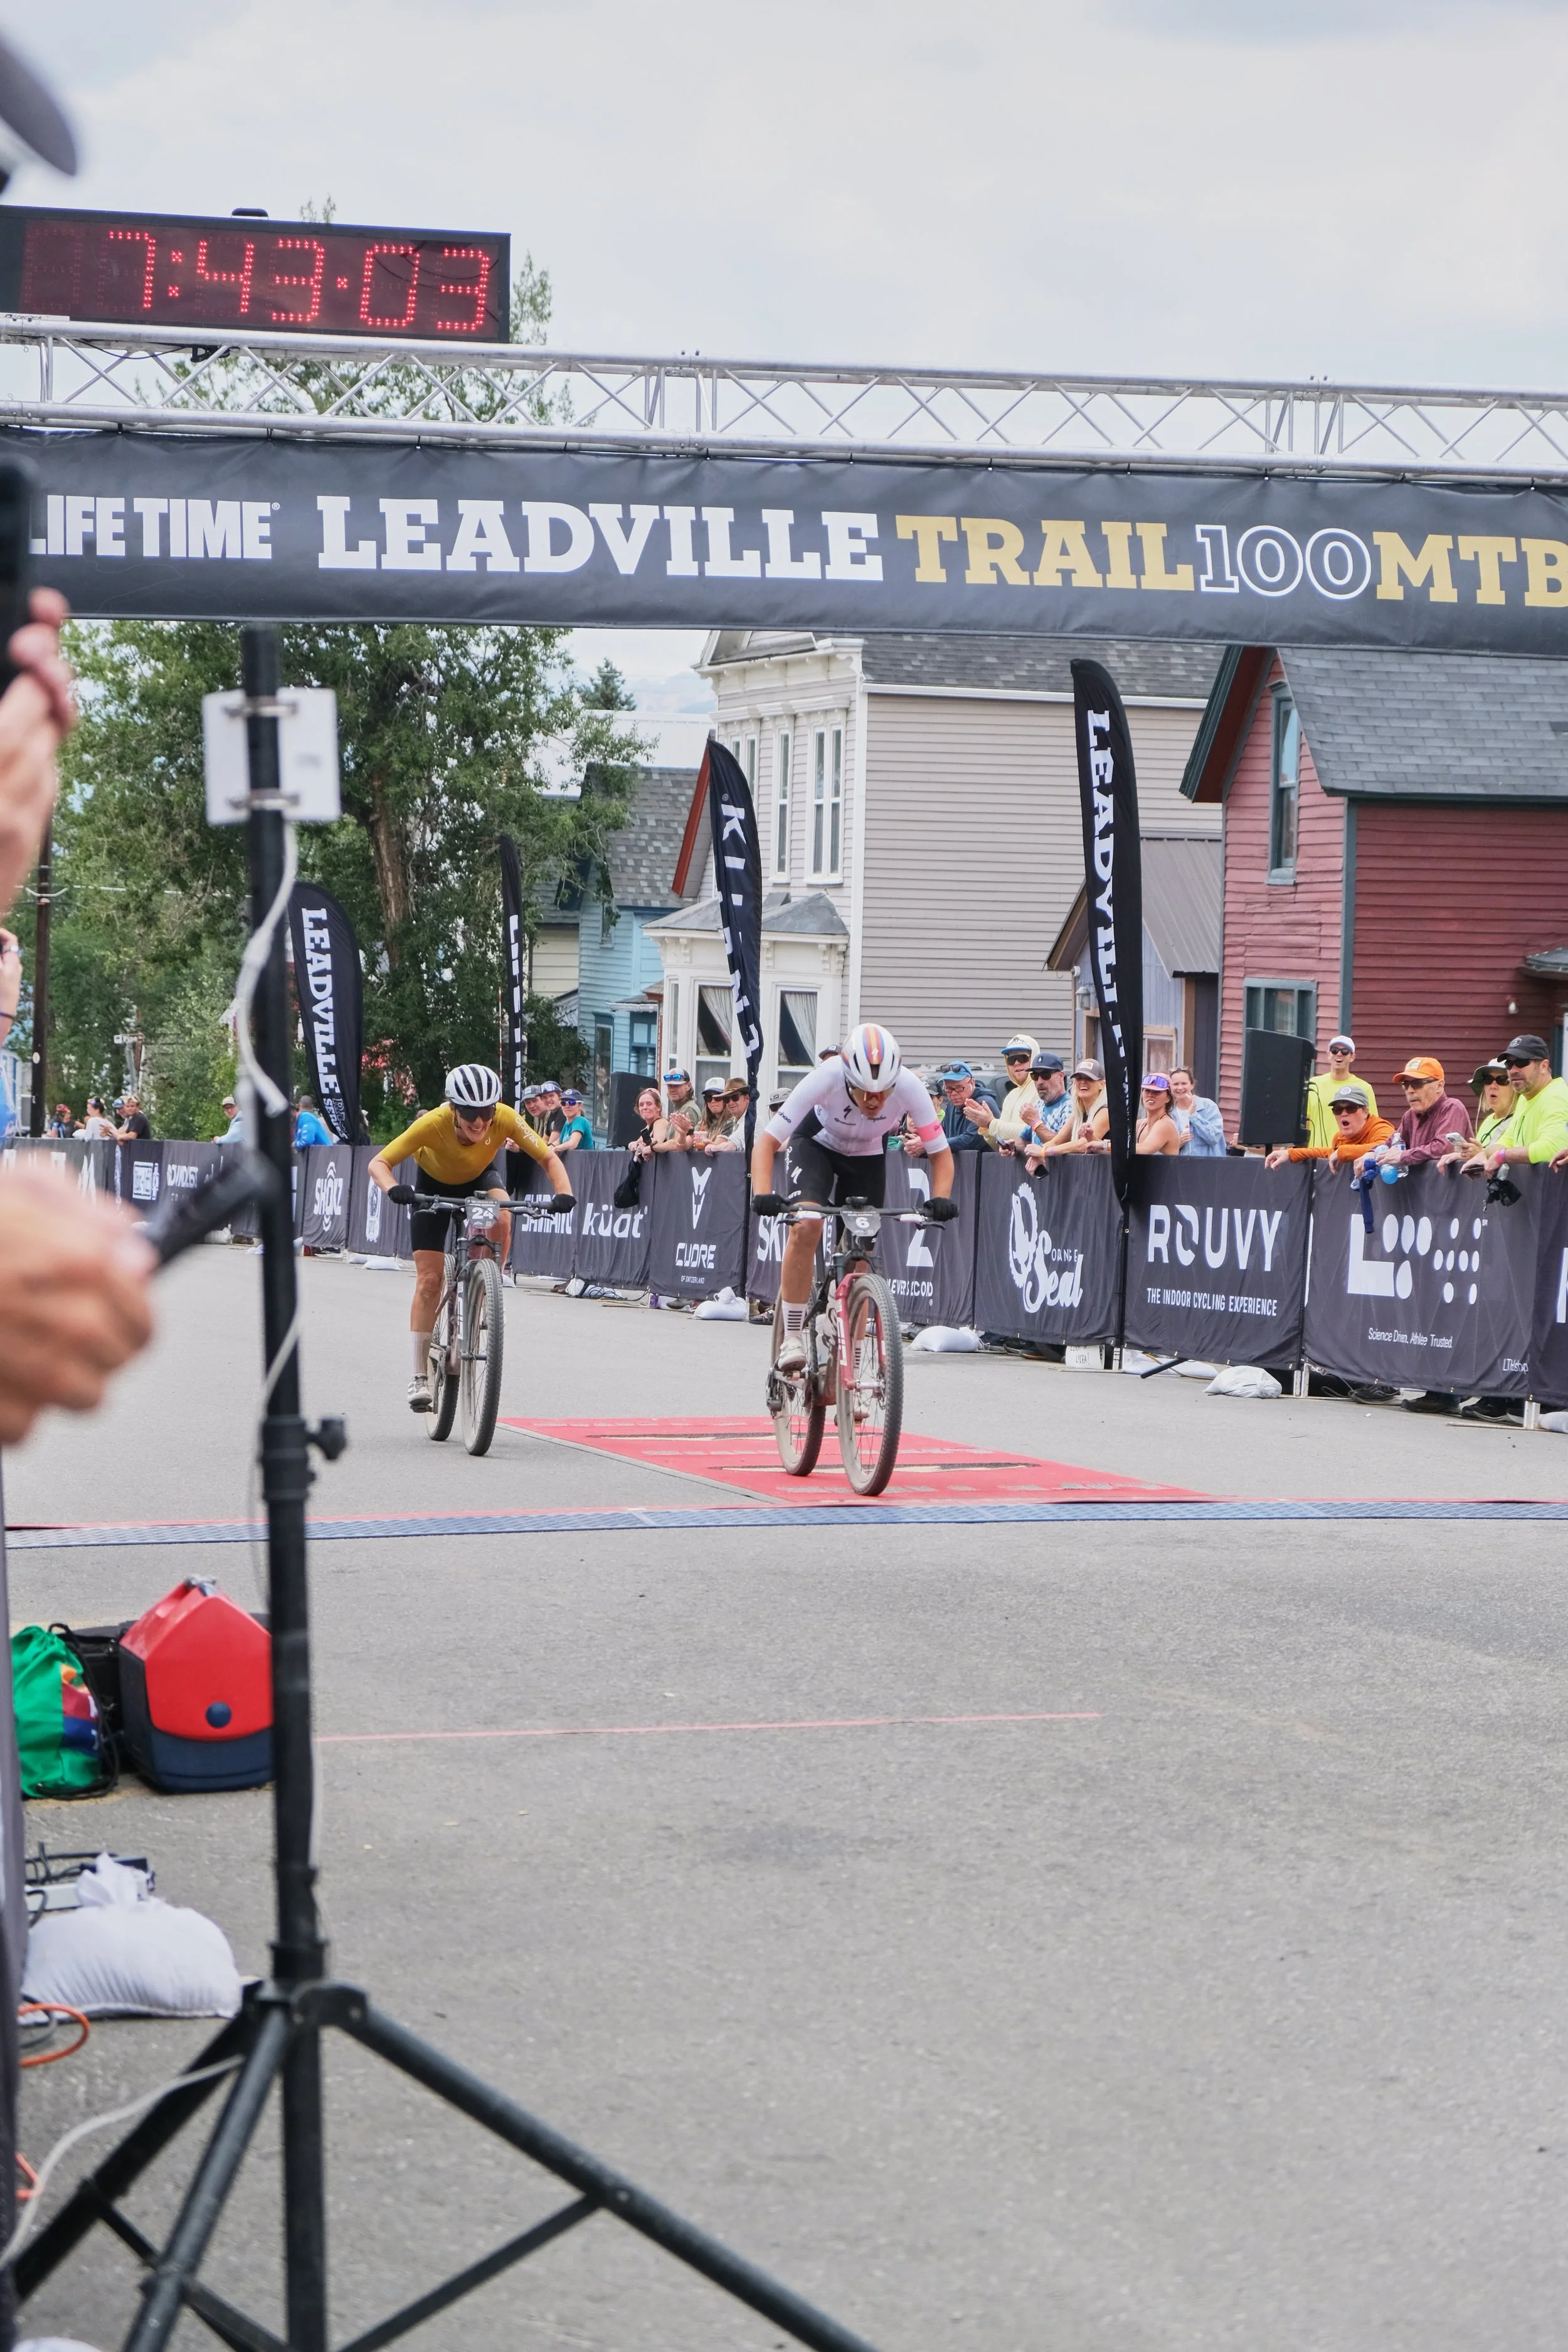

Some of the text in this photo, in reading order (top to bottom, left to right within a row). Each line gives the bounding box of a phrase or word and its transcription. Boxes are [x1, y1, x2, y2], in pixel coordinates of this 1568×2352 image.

[317, 495, 882, 581] LEADVILLE
[895, 514, 1195, 591] TRAIL
[1195, 524, 1372, 600] 100
[1373, 531, 1568, 608] MTB
[302, 908, 341, 1094] LEADVILLE
[472, 1207, 494, 1219] 24
[856, 1217, 870, 1229] 6
[1147, 1204, 1283, 1272] ROUVY
[675, 1242, 717, 1269] CUORE
[1023, 1230, 1084, 1313] Seal
[1147, 1288, 1278, 1316] THE INDOOR CYCLING EXPERIENCE
[1368, 1327, 1393, 1342] Science
